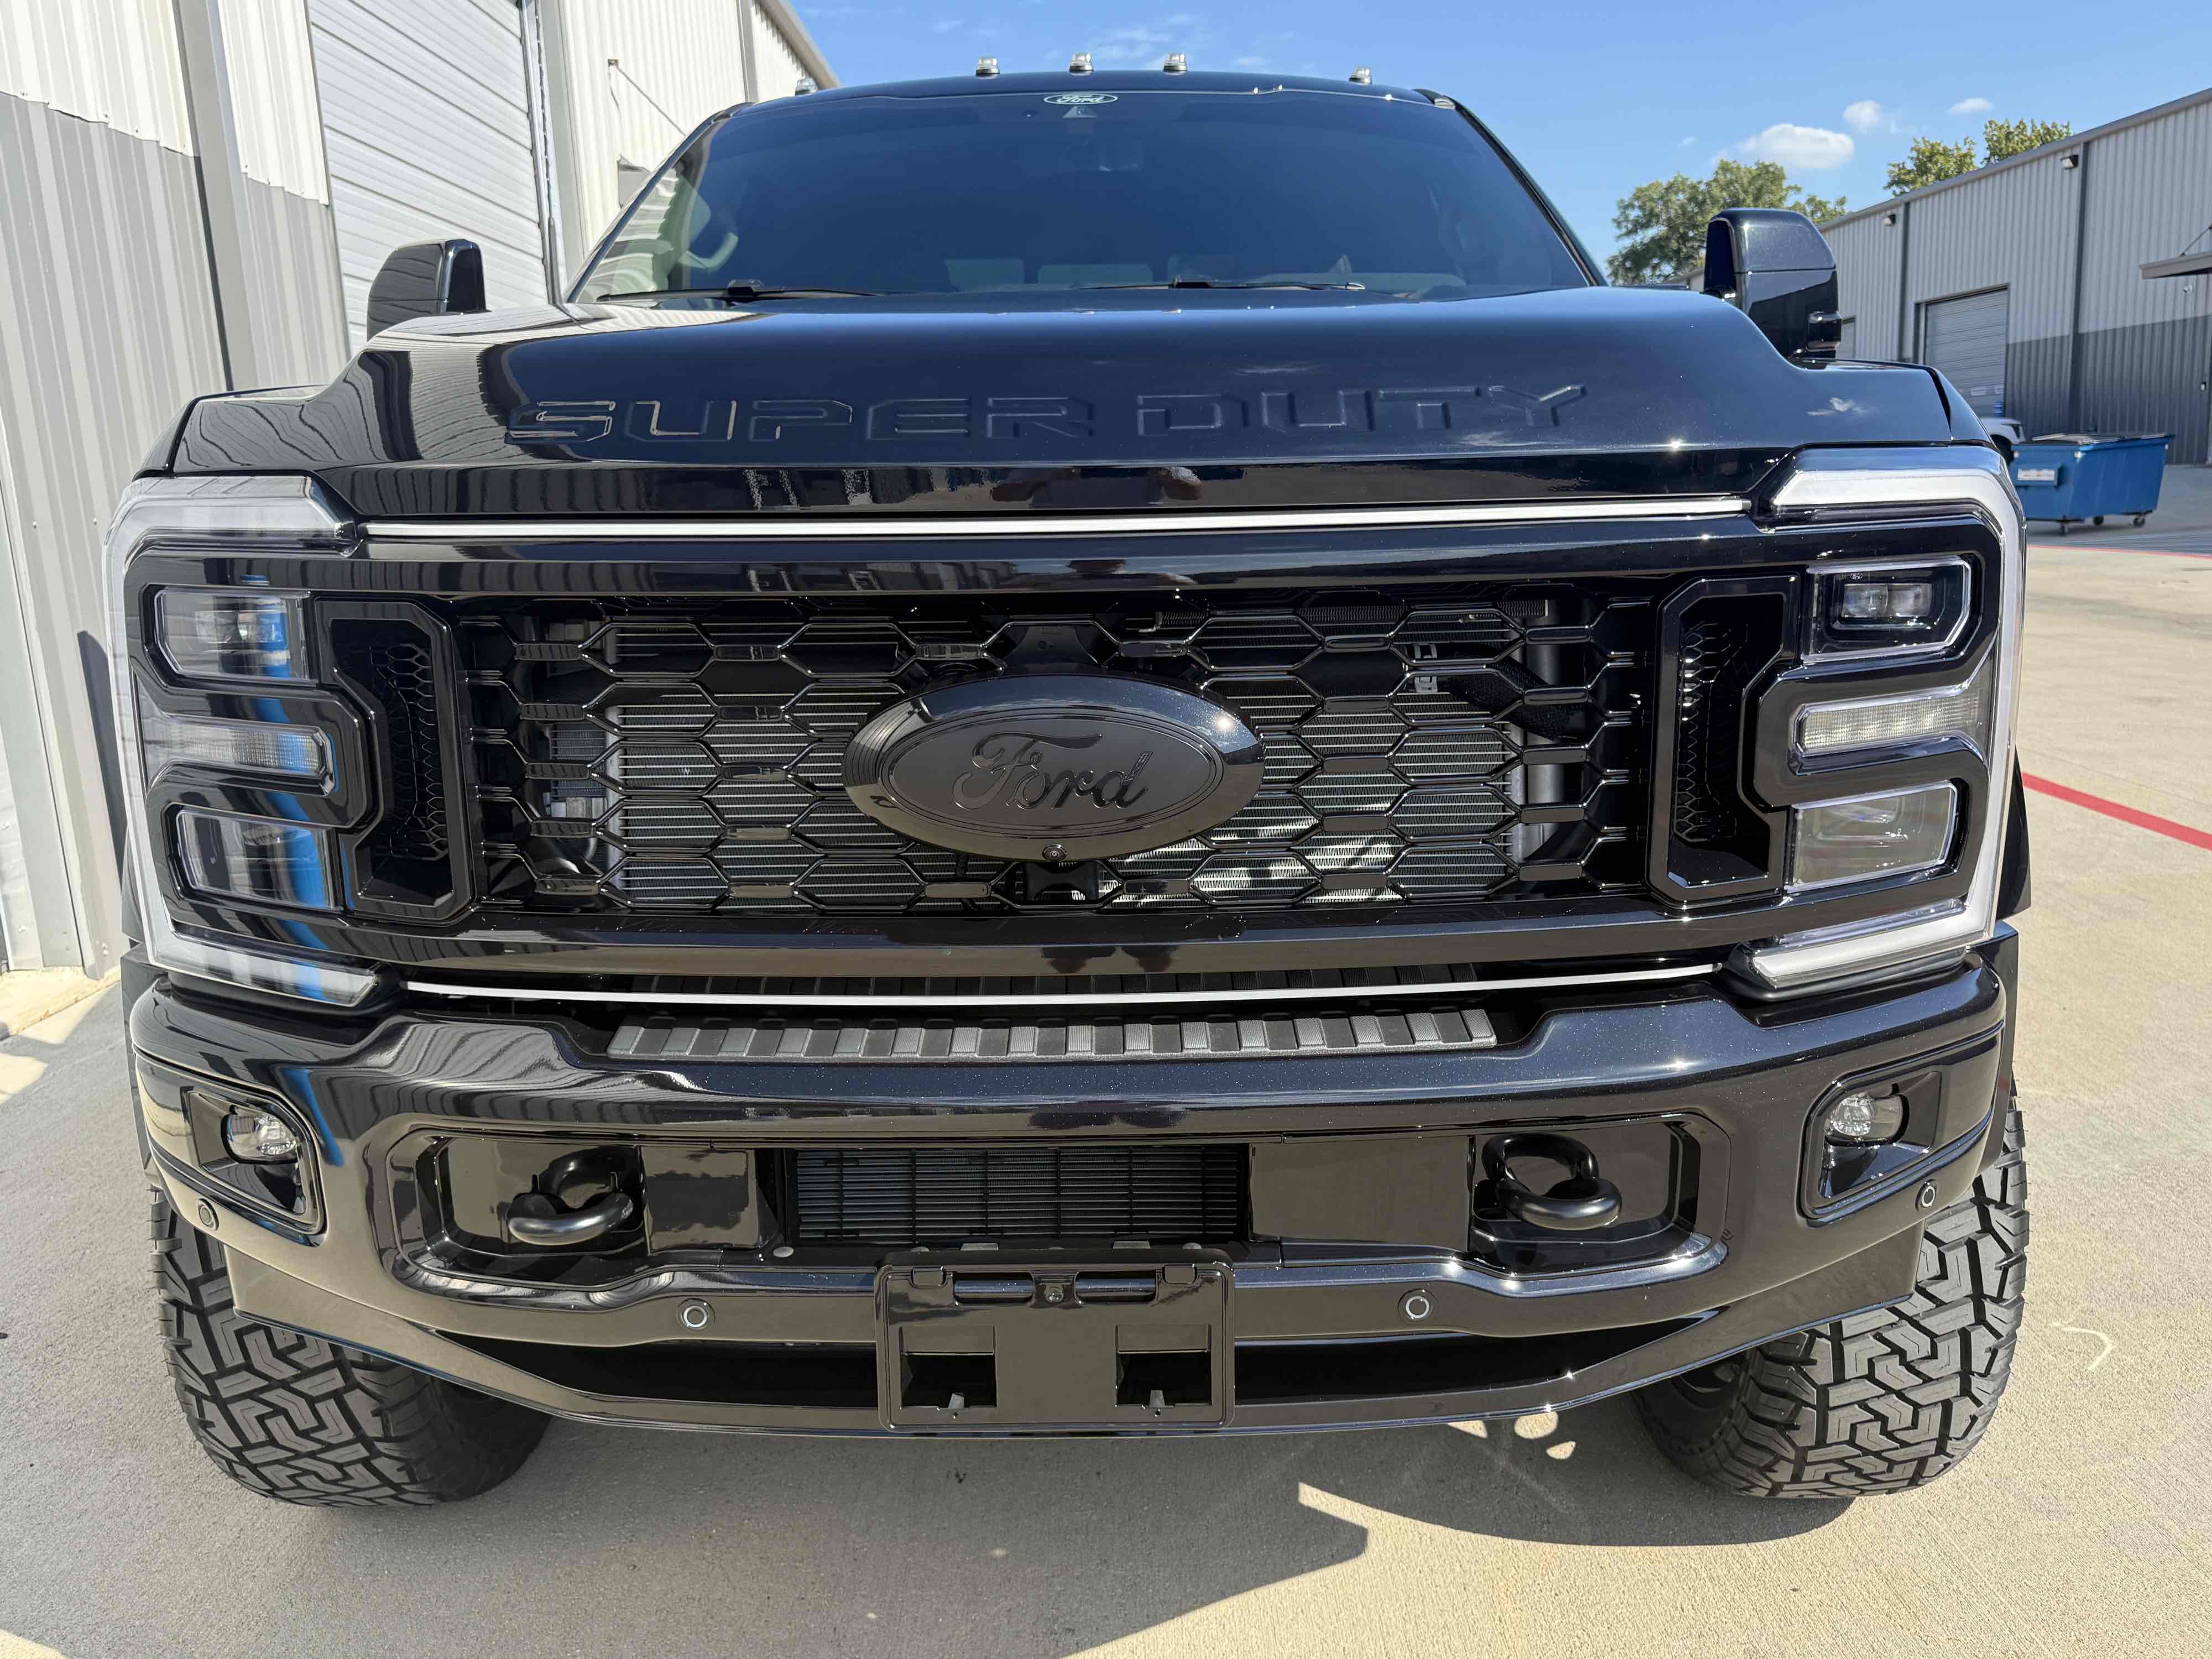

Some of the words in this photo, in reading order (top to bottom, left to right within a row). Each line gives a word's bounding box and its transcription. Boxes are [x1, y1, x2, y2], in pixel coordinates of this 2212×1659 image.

[505, 397, 1093, 442] SUPER
[1137, 383, 1588, 436] DUTY
[952, 731, 1154, 810] Ford
